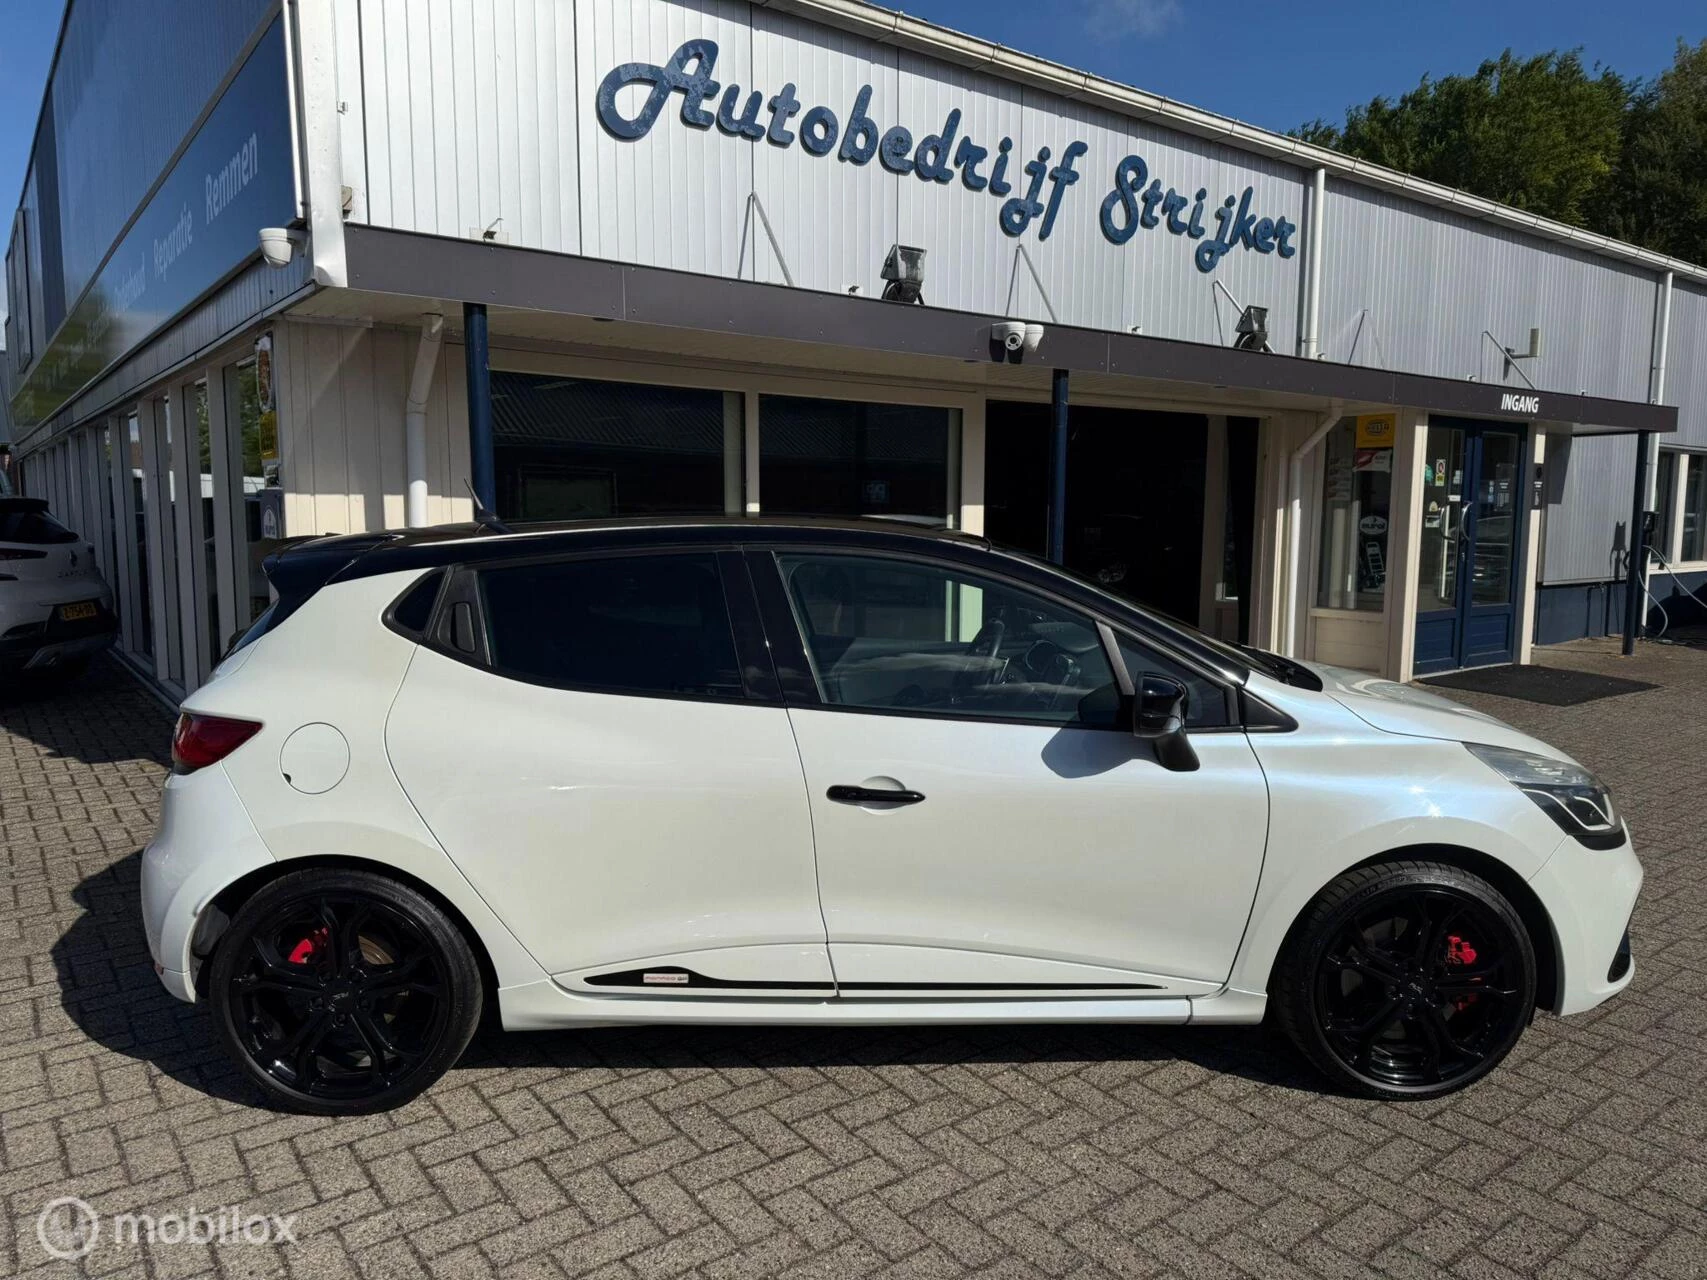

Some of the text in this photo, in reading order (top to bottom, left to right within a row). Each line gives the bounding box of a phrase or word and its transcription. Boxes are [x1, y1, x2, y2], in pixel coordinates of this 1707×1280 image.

[153, 201, 193, 281] Reparatie
[205, 132, 259, 224] Remmen
[596, 38, 1296, 273] Autobedrijf Strijker
[1501, 393, 1540, 413] INGANG
